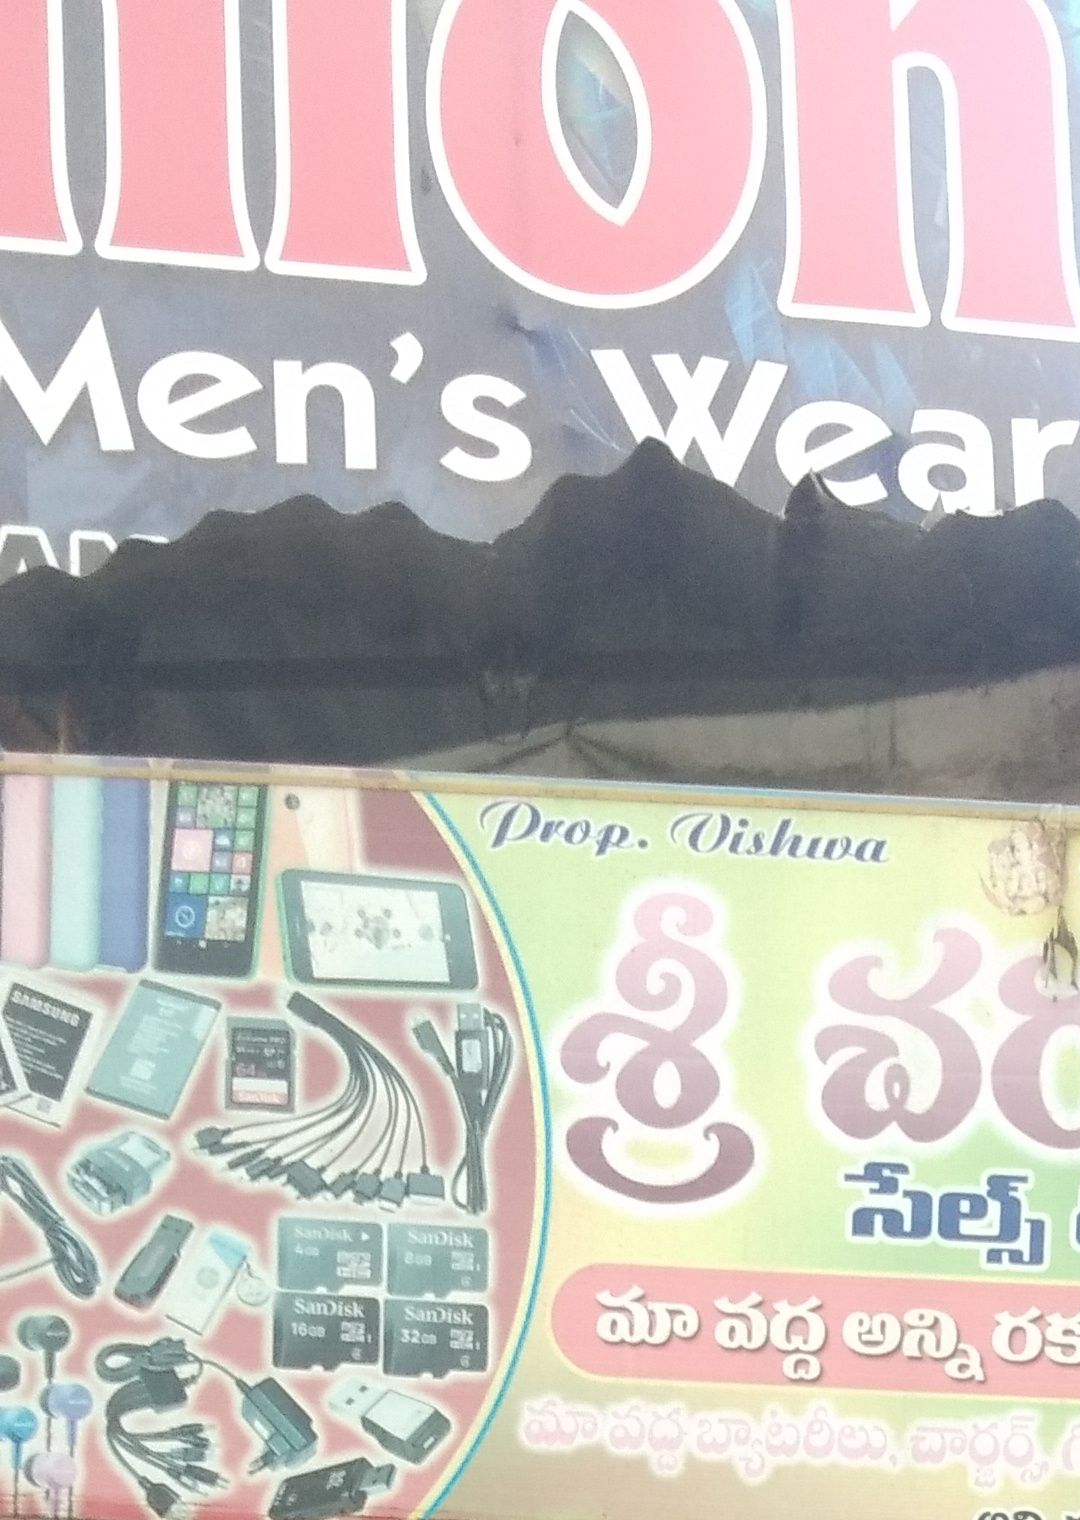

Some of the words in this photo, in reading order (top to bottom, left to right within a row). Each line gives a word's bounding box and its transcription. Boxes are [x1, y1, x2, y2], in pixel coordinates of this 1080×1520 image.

[0, 307, 533, 483] Men's
[480, 800, 650, 855] Prop.
[671, 811, 889, 864] Vishwa
[11, 991, 80, 1027] SAMSUNG
[558, 892, 756, 1206] శ్రీ
[407, 1230, 475, 1248] SanDisk
[843, 1162, 1046, 1266] సేల్స్
[294, 1299, 366, 1318] SanDisk
[404, 1306, 475, 1325] SanDisk
[596, 1287, 698, 1347] మా
[714, 1294, 827, 1380] వద్ద
[843, 1306, 985, 1383] అన్ని
[524, 1399, 598, 1446] మా
